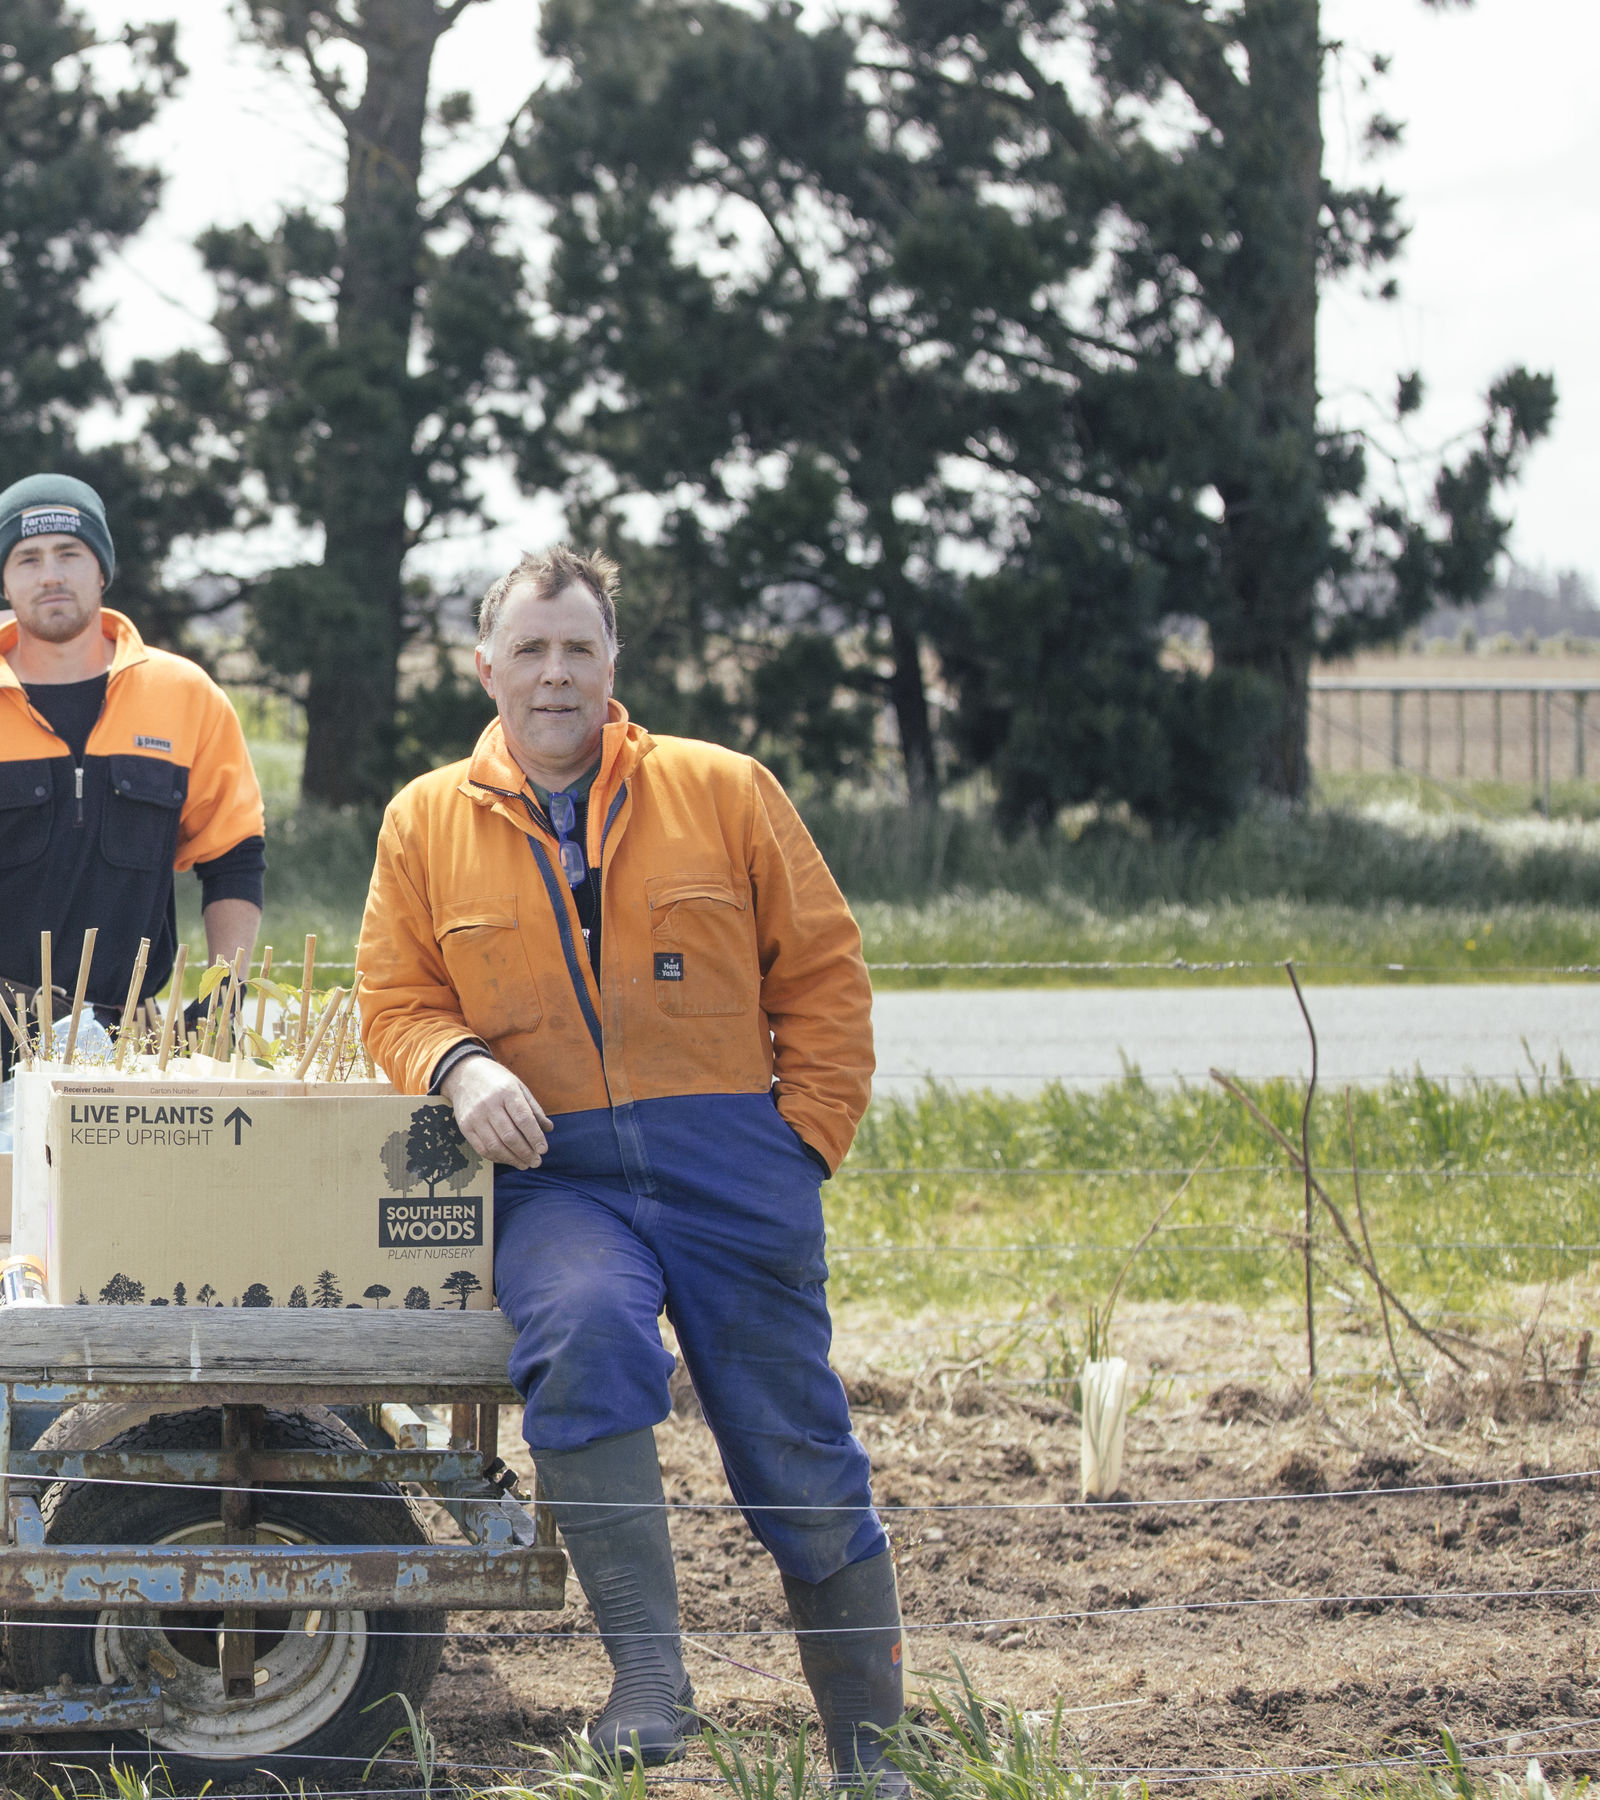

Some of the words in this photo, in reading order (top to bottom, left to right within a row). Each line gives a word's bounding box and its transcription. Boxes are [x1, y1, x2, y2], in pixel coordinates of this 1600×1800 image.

[21, 513, 81, 528] Farmlands
[21, 522, 76, 537] Horticulture
[70, 1105, 119, 1123] LIVE
[125, 1106, 214, 1124] PLANTS
[71, 1128, 120, 1144] KEEP
[126, 1129, 214, 1145] UPRIGHT
[386, 1205, 475, 1220] SOUTHERN
[386, 1220, 476, 1241] WOODS
[387, 1249, 423, 1260] PLANT
[424, 1248, 476, 1259] NURSERY
